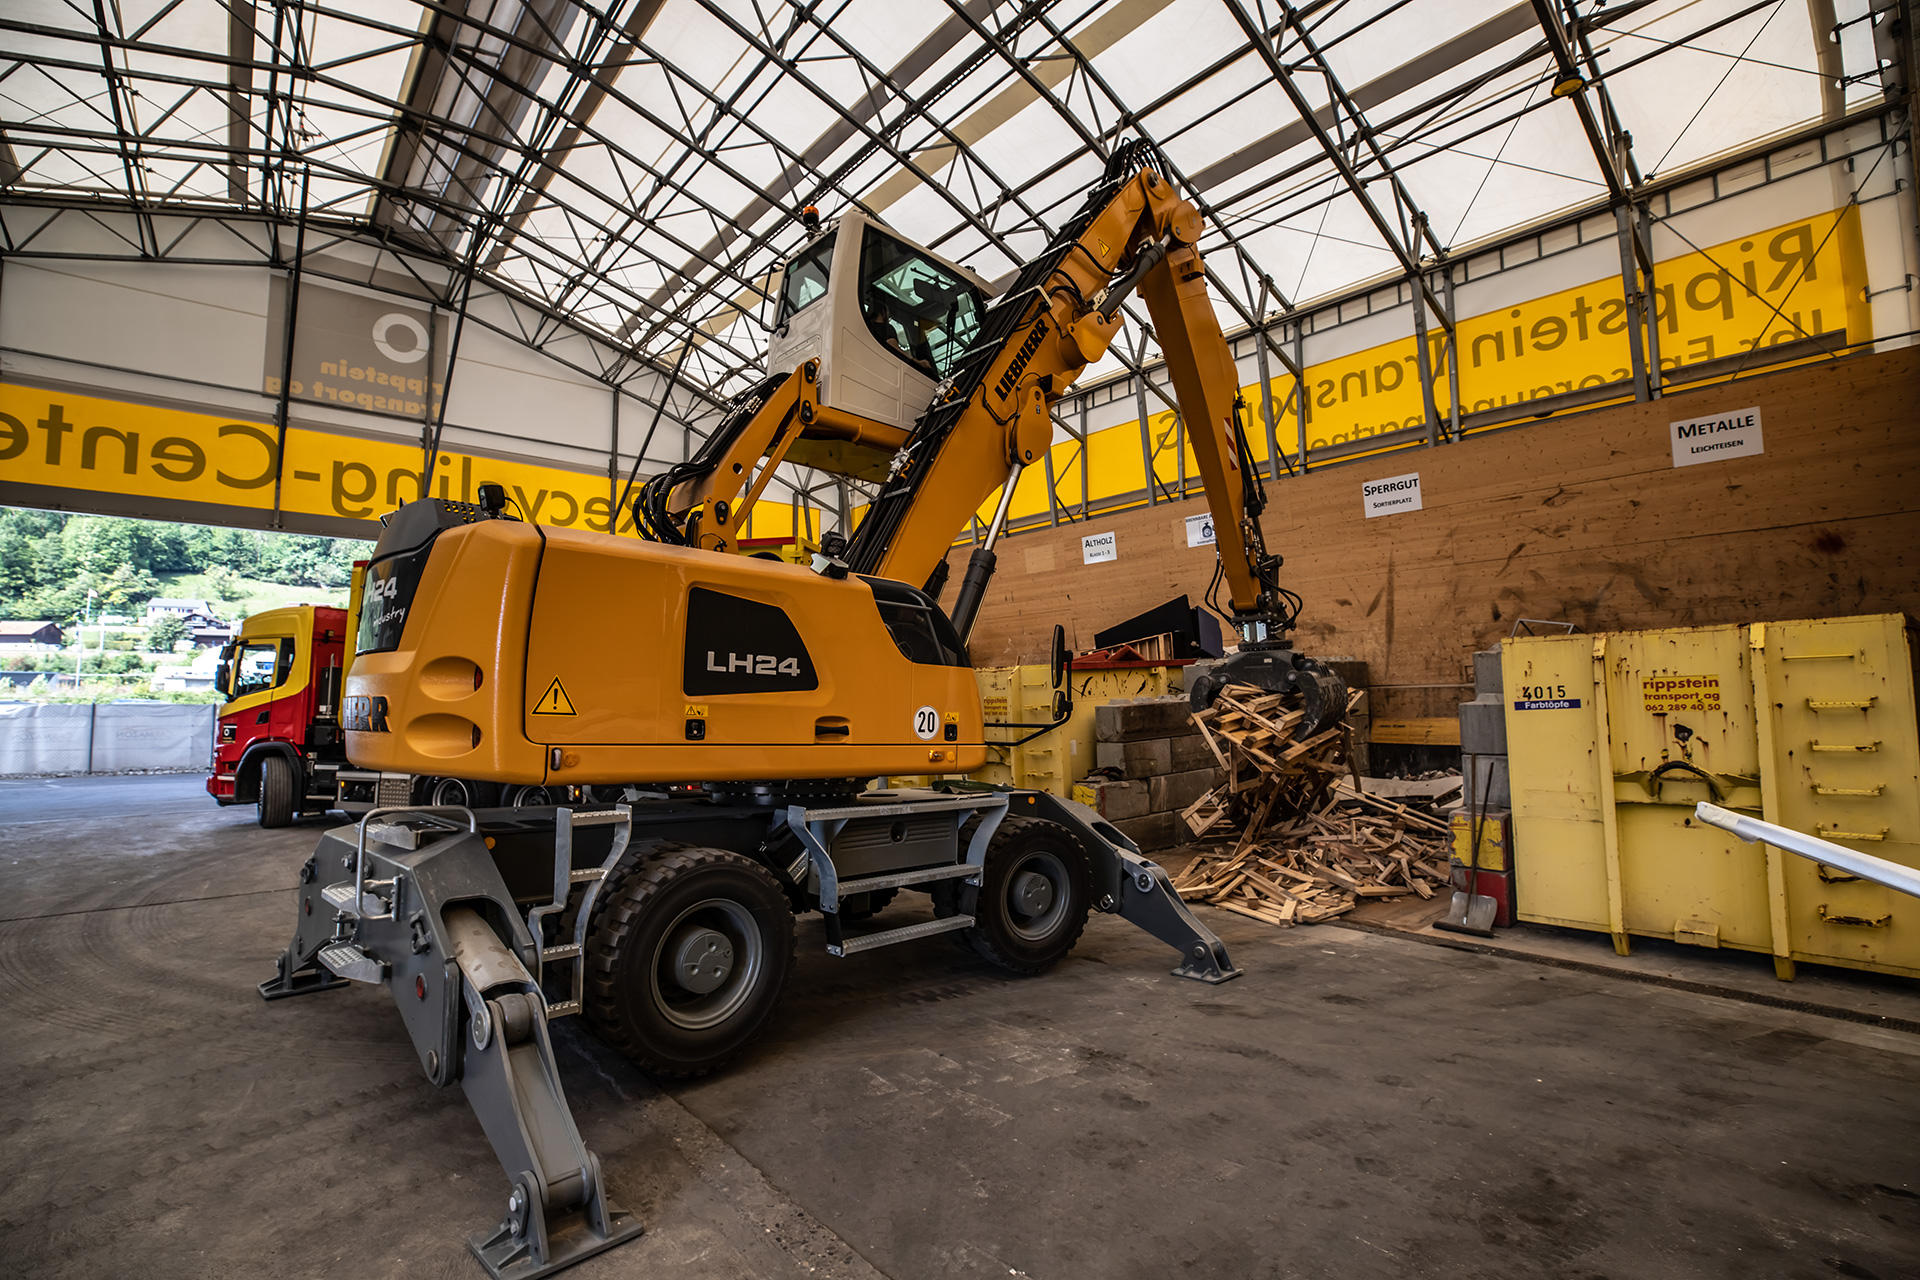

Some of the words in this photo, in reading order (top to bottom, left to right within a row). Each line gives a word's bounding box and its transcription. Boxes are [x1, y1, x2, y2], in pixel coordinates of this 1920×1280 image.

[994, 318, 1050, 402] LIEBHERR
[1677, 415, 1755, 439] METALLE
[1691, 439, 1744, 454] LEICHTEISEN
[1364, 478, 1419, 497] SPERRGUT
[706, 650, 801, 677] LH24
[1642, 676, 1719, 692] rippstein
[1522, 685, 1566, 700] 4015
[1644, 692, 1699, 702] transport
[1703, 693, 1720, 701] ag
[1524, 700, 1570, 709] Farbtöpfe
[1667, 703, 1688, 711] 289
[1690, 703, 1704, 711] 40
[918, 711, 935, 733] 20
